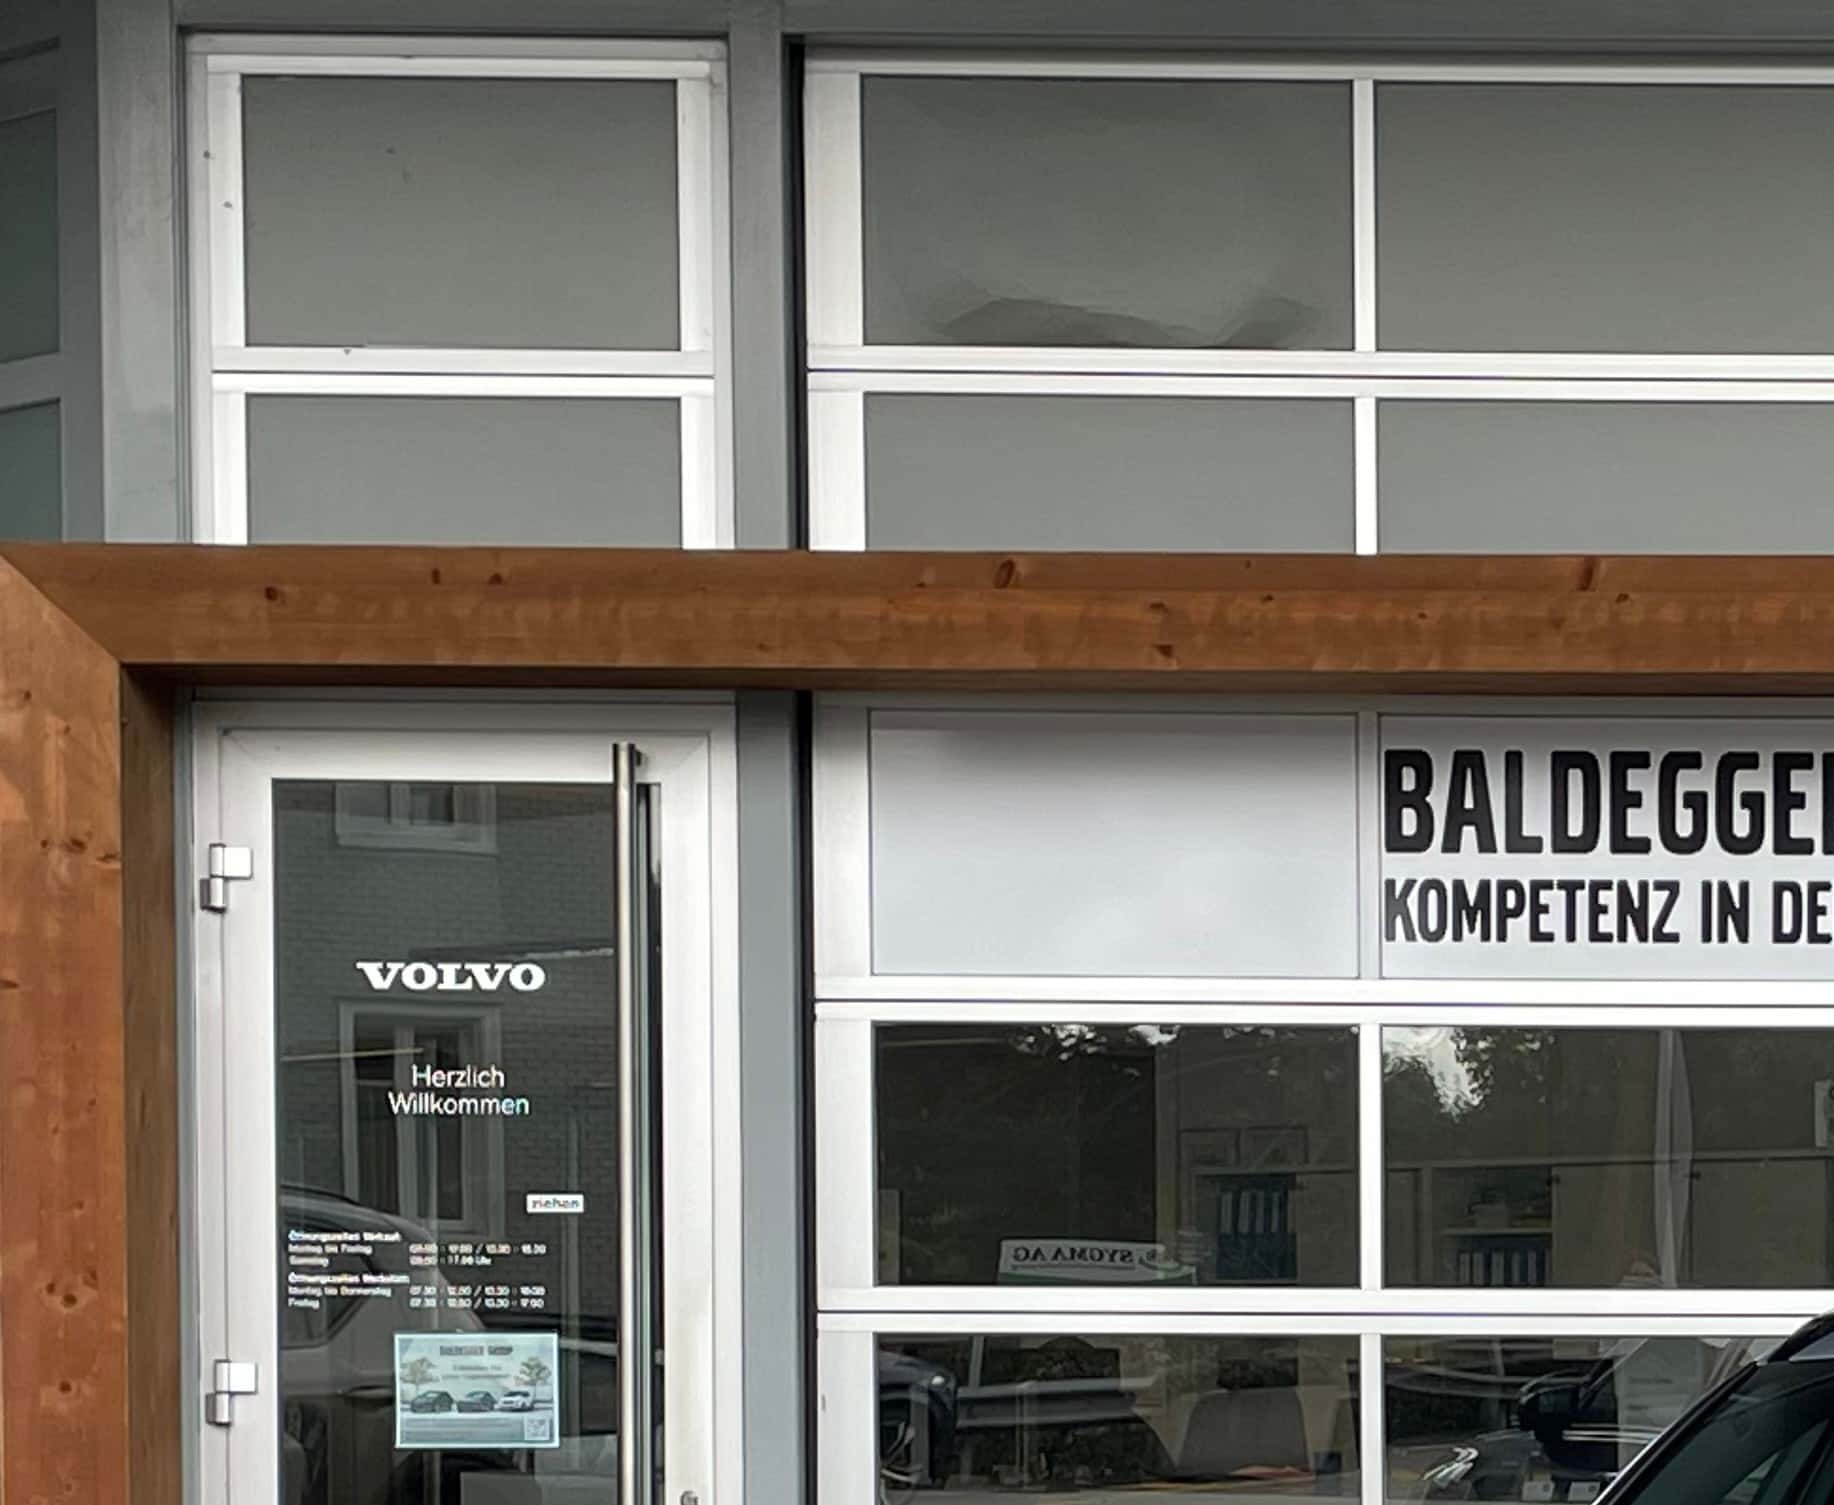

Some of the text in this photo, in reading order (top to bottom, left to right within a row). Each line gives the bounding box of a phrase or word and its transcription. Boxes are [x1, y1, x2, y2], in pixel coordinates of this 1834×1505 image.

[1385, 879, 1680, 942] KOMPETENZ
[1701, 880, 1750, 943] IN
[356, 962, 546, 991] VOLVO
[411, 1063, 505, 1088] Herzlich
[388, 1091, 530, 1116] Willkommen
